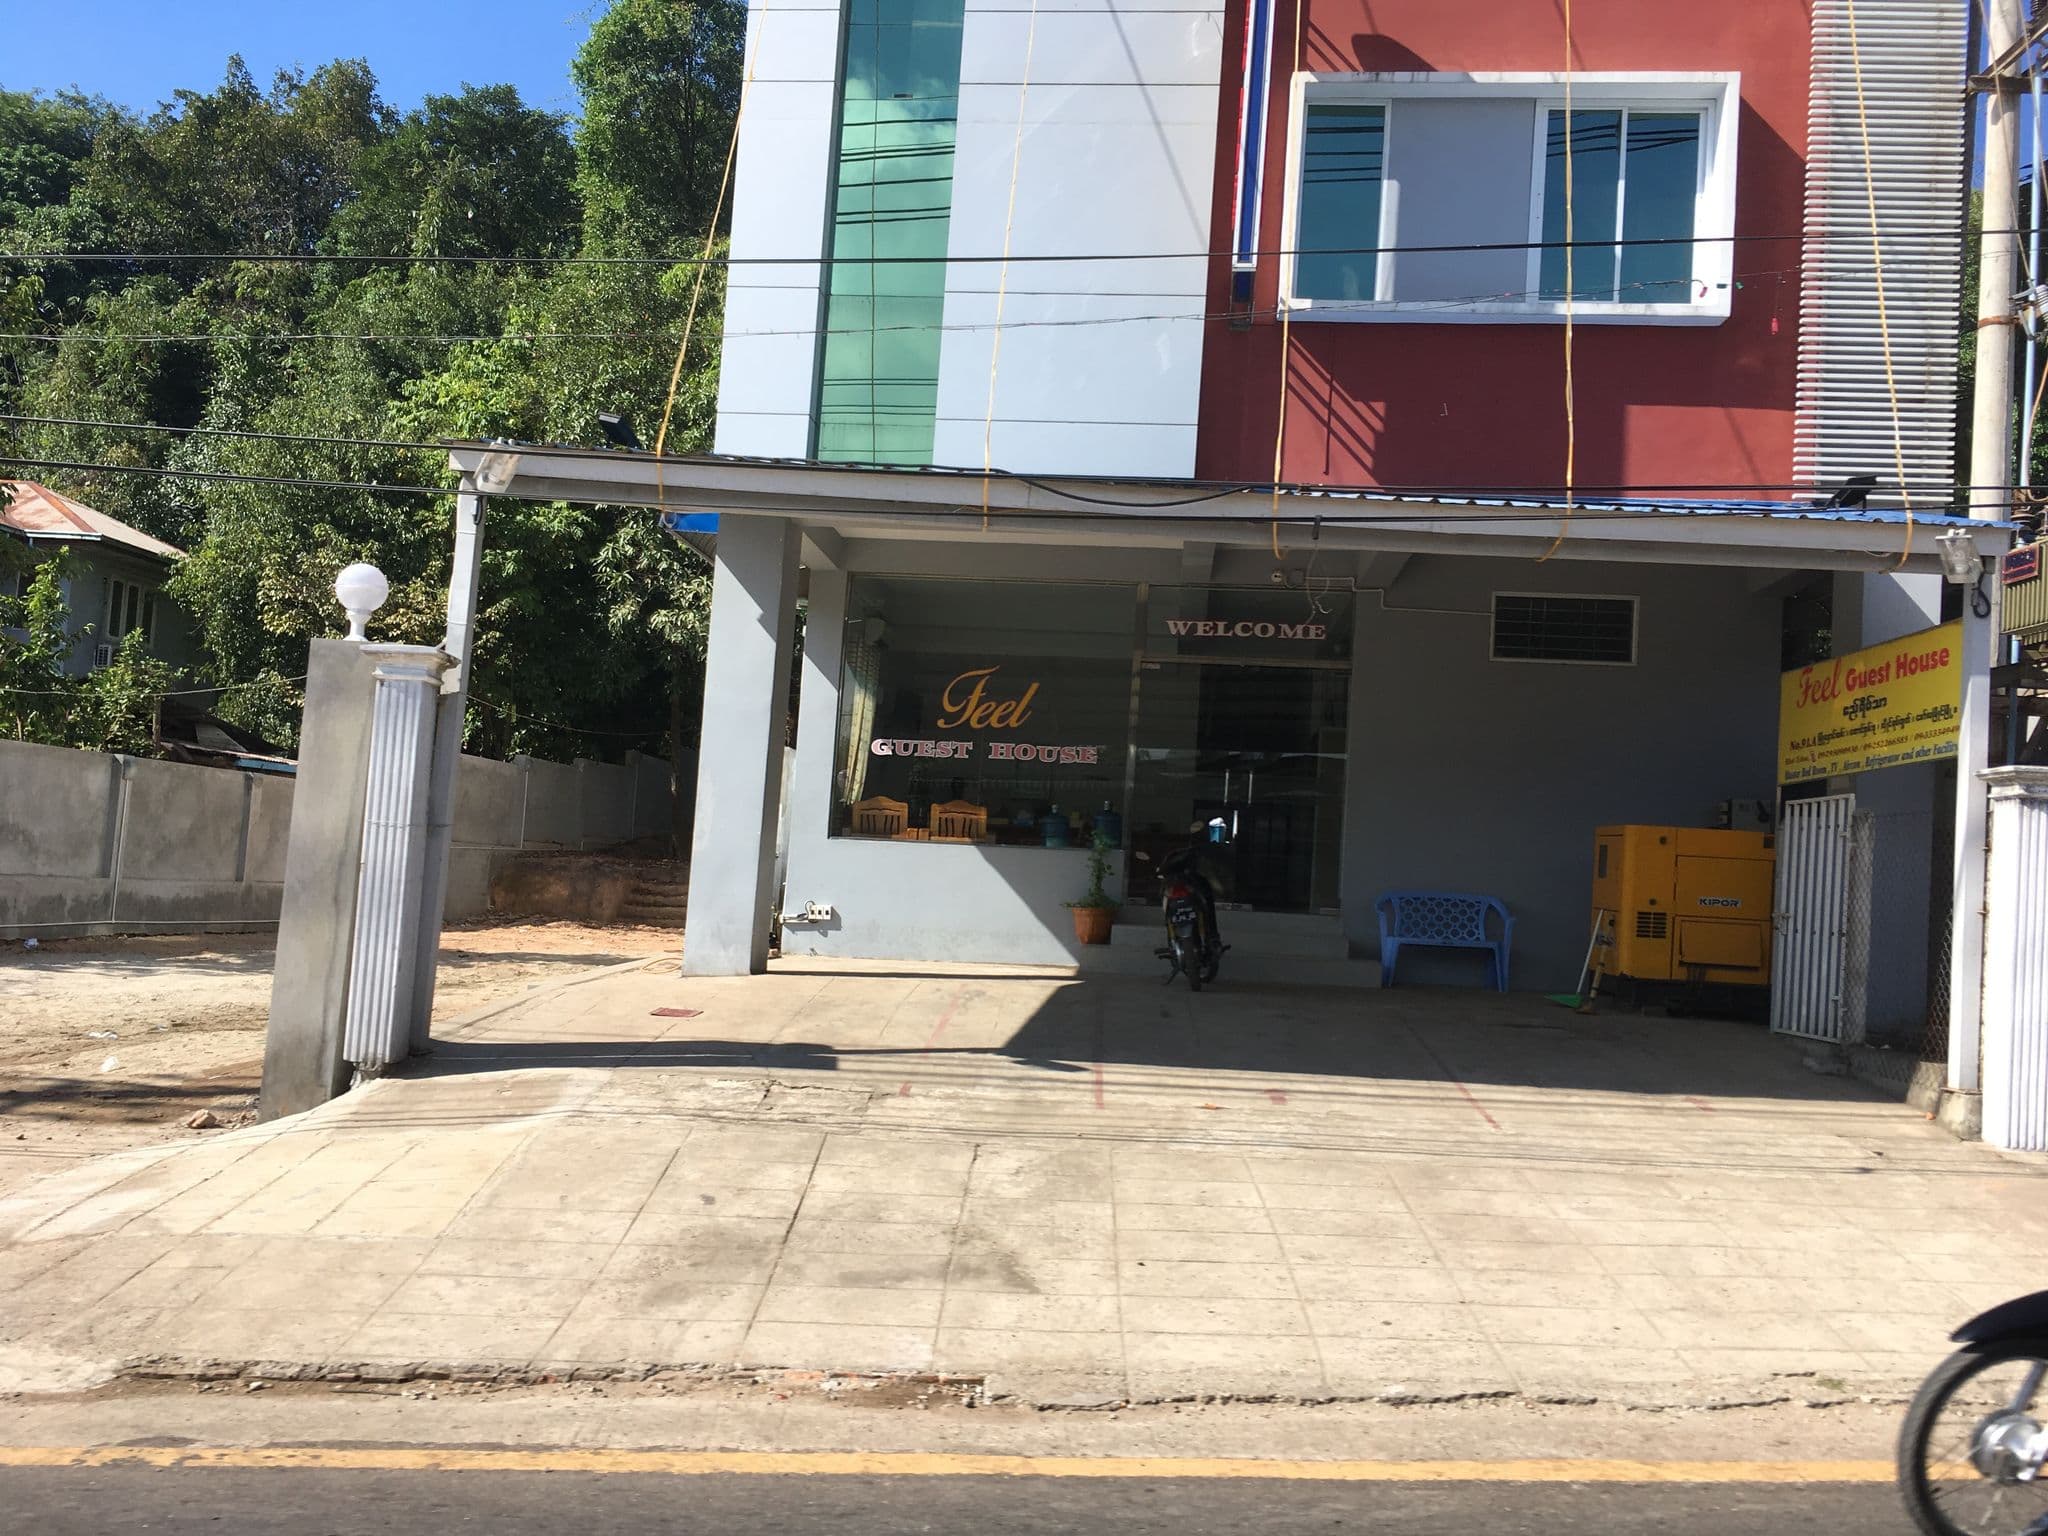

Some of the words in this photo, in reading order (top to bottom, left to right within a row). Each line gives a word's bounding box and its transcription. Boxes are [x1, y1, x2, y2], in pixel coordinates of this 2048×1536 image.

[1166, 620, 1327, 640] WELCOME
[1797, 659, 1841, 708] Feel
[1845, 667, 1891, 691] Guest
[1896, 648, 1950, 678] House
[936, 665, 1040, 729] Feel
[870, 738, 973, 760] GUEST
[988, 742, 1098, 765] HOUSE
[1699, 898, 1739, 907] KIPOR
